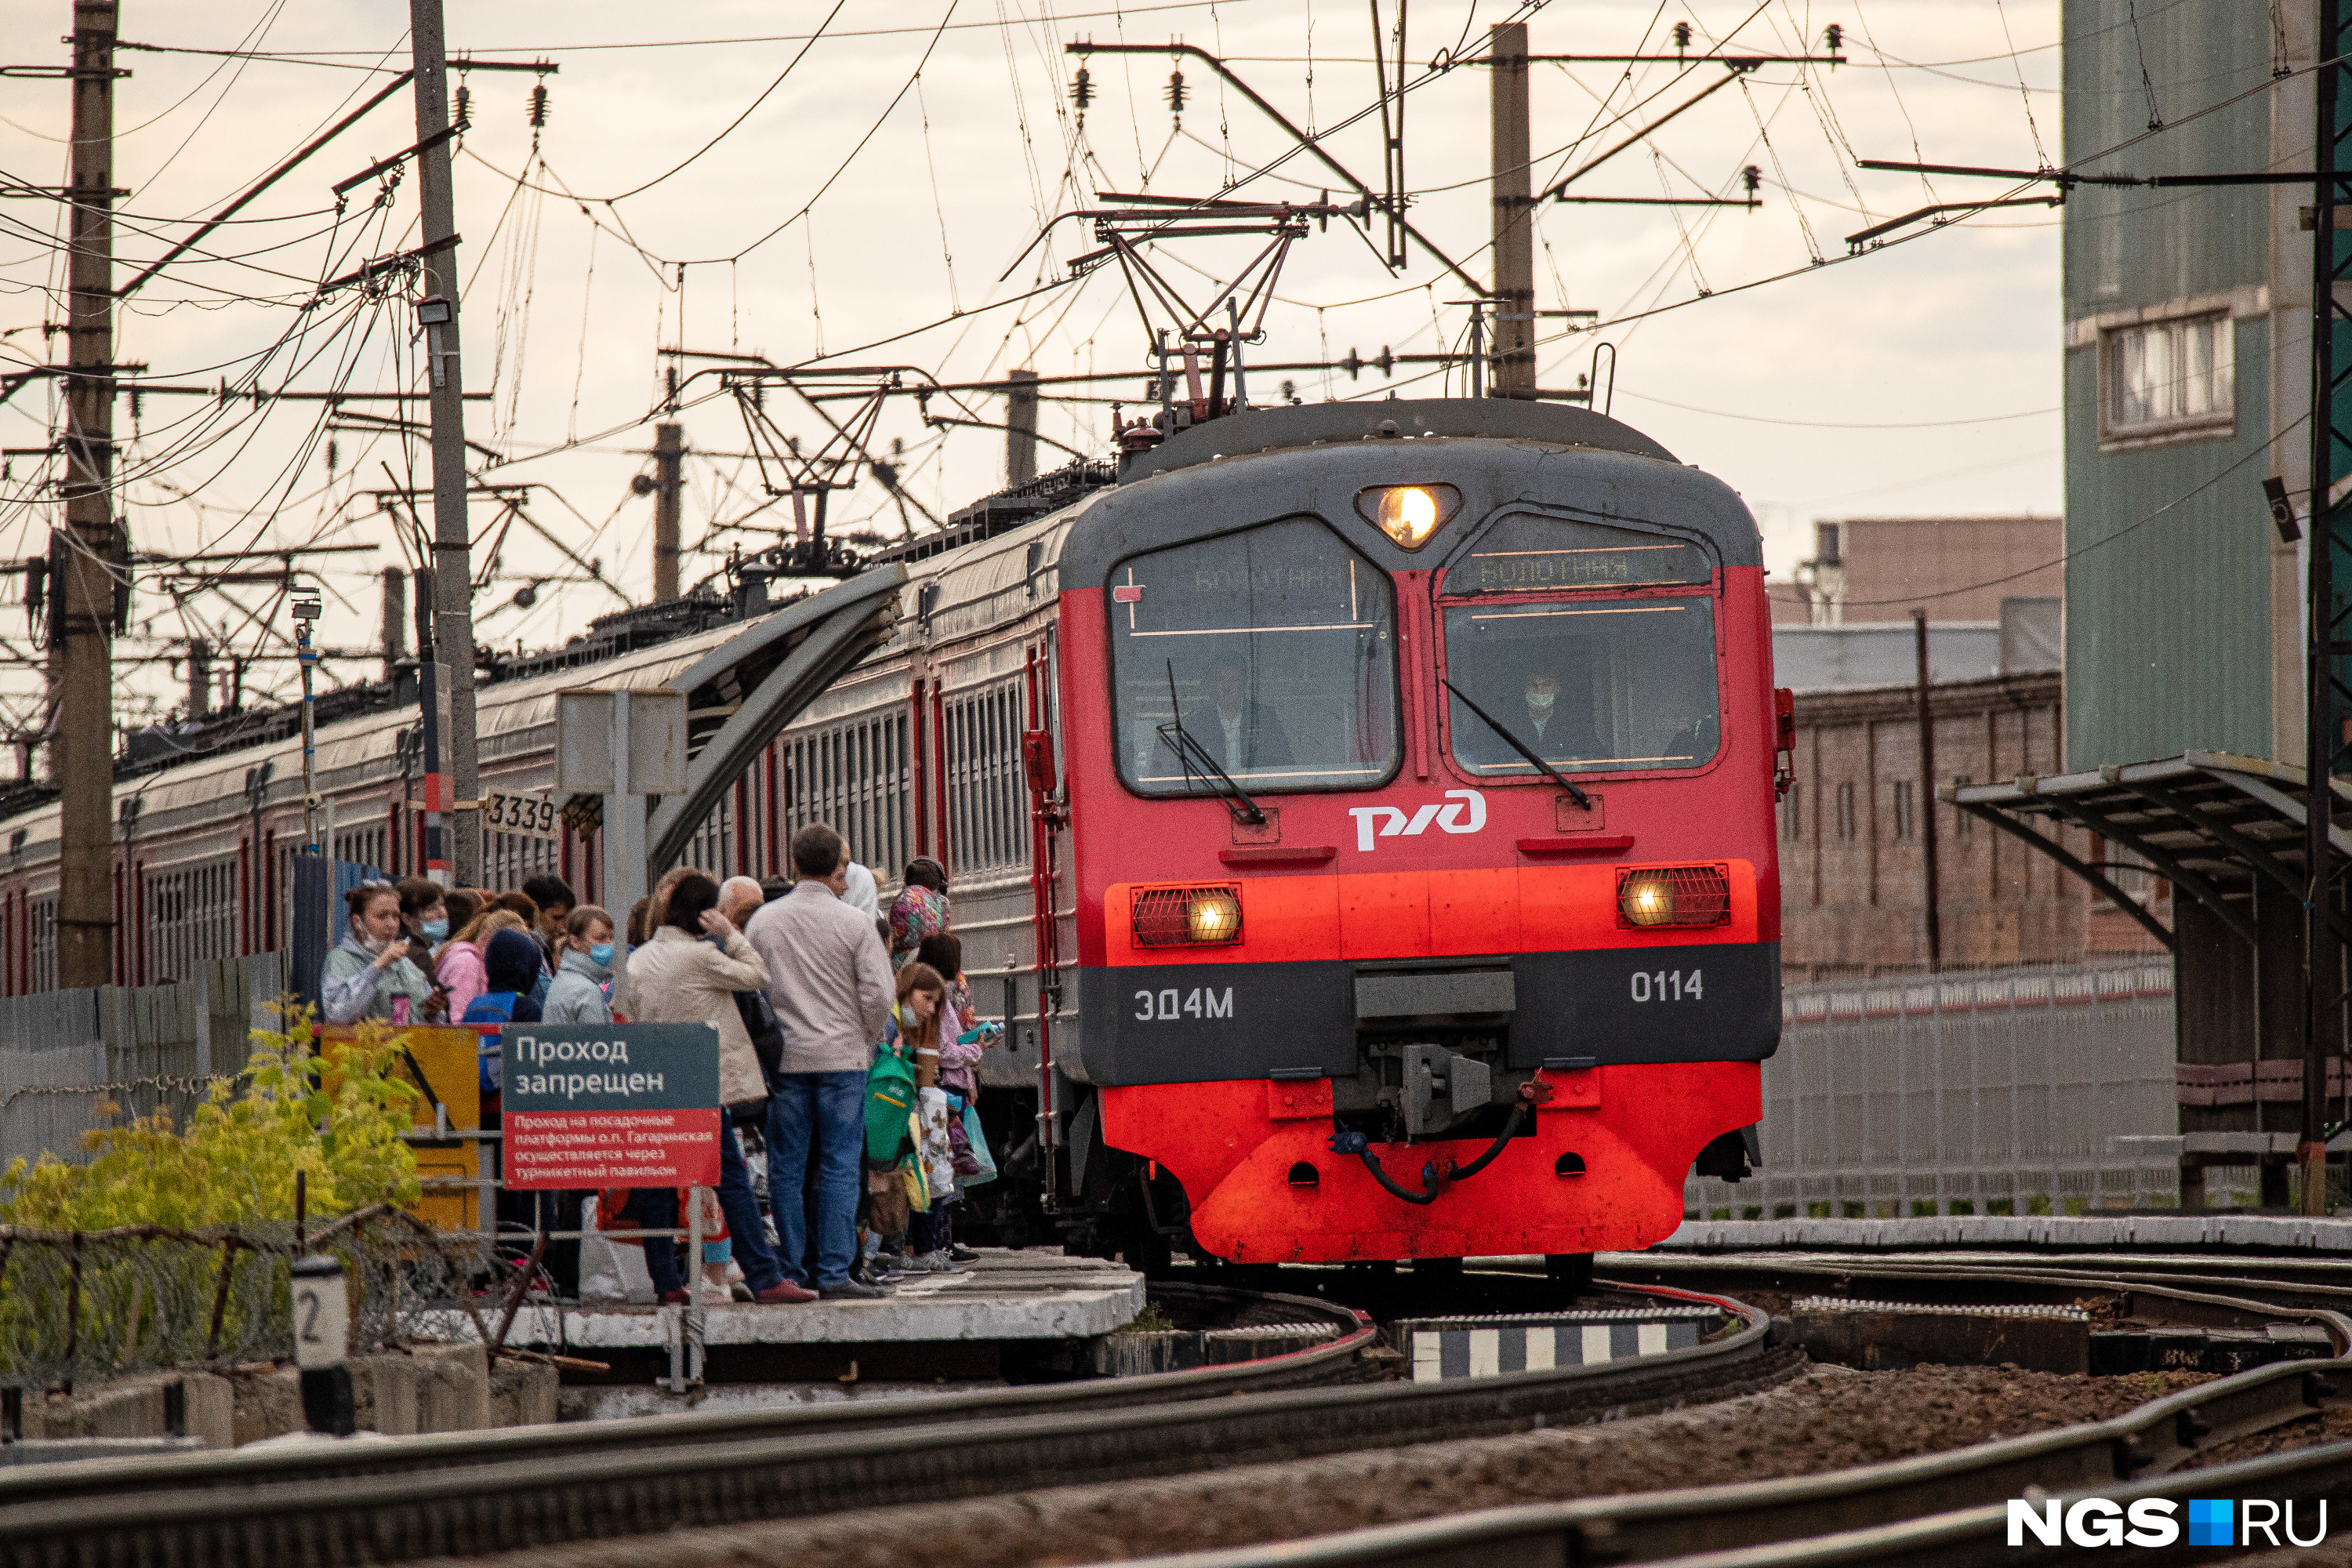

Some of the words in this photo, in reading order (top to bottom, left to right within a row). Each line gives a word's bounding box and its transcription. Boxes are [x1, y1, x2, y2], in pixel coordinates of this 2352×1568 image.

[488, 793, 555, 832] 3339
[1631, 969, 1703, 1002] 0114
[1134, 987, 1233, 1020] ЭД4М
[516, 1036, 629, 1067] Проход
[515, 1072, 665, 1099] запрещен
[514, 1116, 568, 1131] Проход
[569, 1116, 586, 1127] на
[589, 1116, 674, 1128] посадочные
[514, 1132, 596, 1147] платформы
[627, 1131, 713, 1145] Гагаринская
[514, 1150, 622, 1165] осуществляется
[625, 1149, 666, 1162] через
[514, 1164, 607, 1182] турникетный
[609, 1166, 677, 1177] павильон
[298, 1289, 323, 1344] 2
